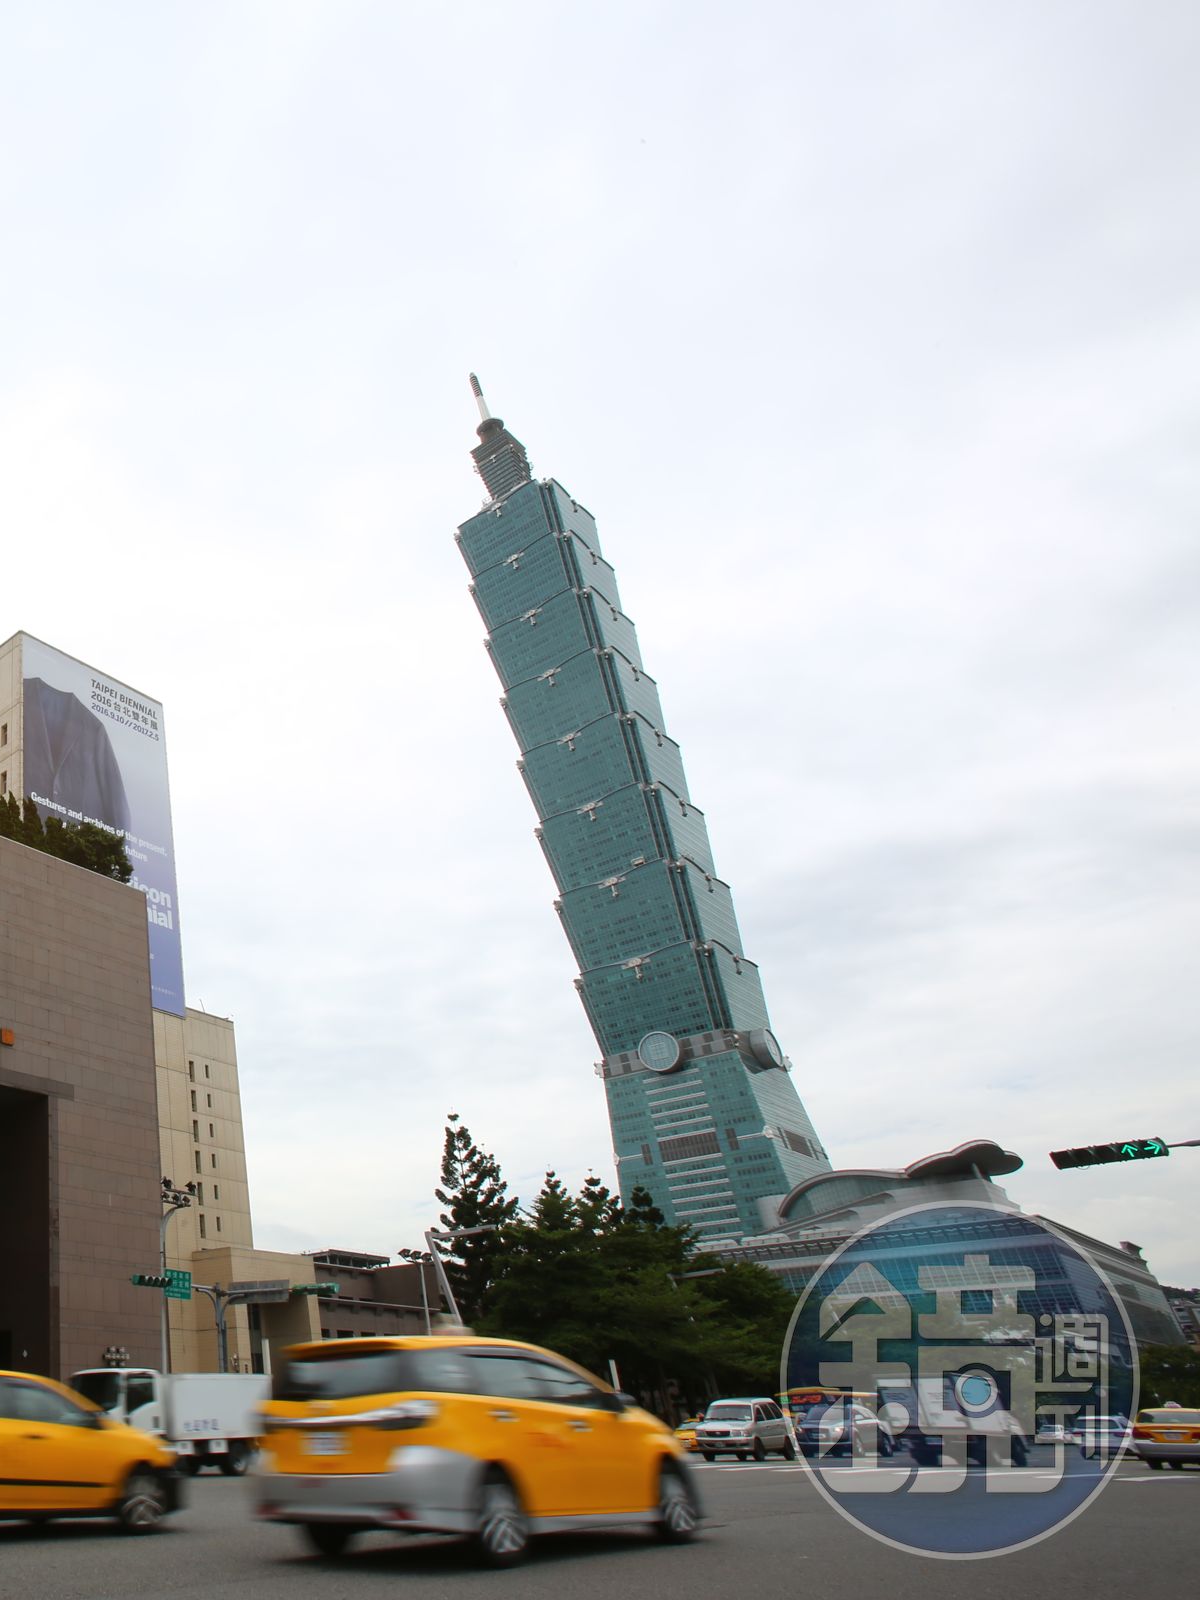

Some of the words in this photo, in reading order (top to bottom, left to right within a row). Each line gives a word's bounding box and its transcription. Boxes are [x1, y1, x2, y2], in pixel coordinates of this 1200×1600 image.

[90, 678, 118, 699] TAIPEI
[119, 693, 158, 720] BIENNIAL
[90, 690, 112, 709] 2016
[30, 791, 67, 815] Gestures
[67, 808, 83, 821] and
[83, 814, 116, 836] archives
[116, 828, 125, 837] of
